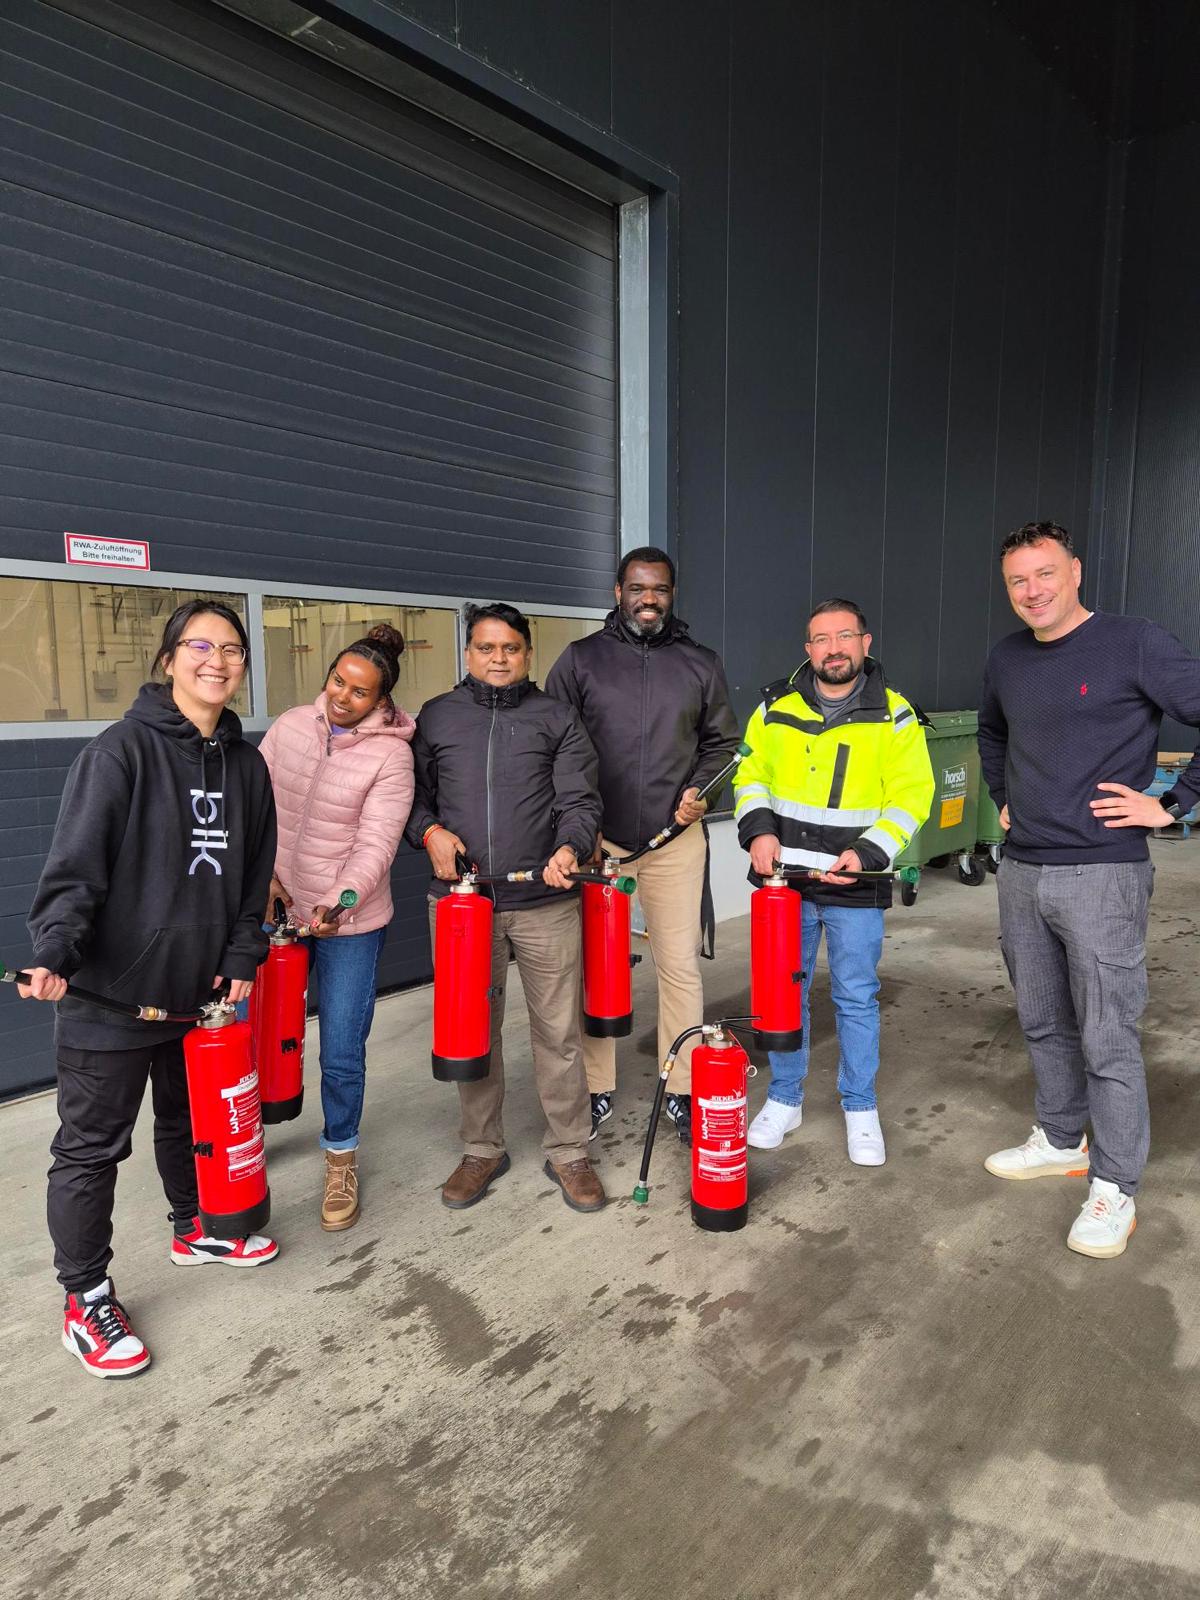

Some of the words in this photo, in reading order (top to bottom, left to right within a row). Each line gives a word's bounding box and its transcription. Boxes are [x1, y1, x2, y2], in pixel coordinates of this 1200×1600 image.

[73, 541, 142, 555] RWA-Zuluftöffnung
[82, 551, 100, 560] Bitte
[101, 553, 135, 562] freihalten
[944, 768, 966, 784] horsch
[227, 1097, 235, 1110] 1
[228, 1109, 239, 1123] 2
[702, 1108, 707, 1118] 1
[230, 1122, 240, 1134] 3
[702, 1119, 708, 1128] 2
[702, 1128, 709, 1139] 3
